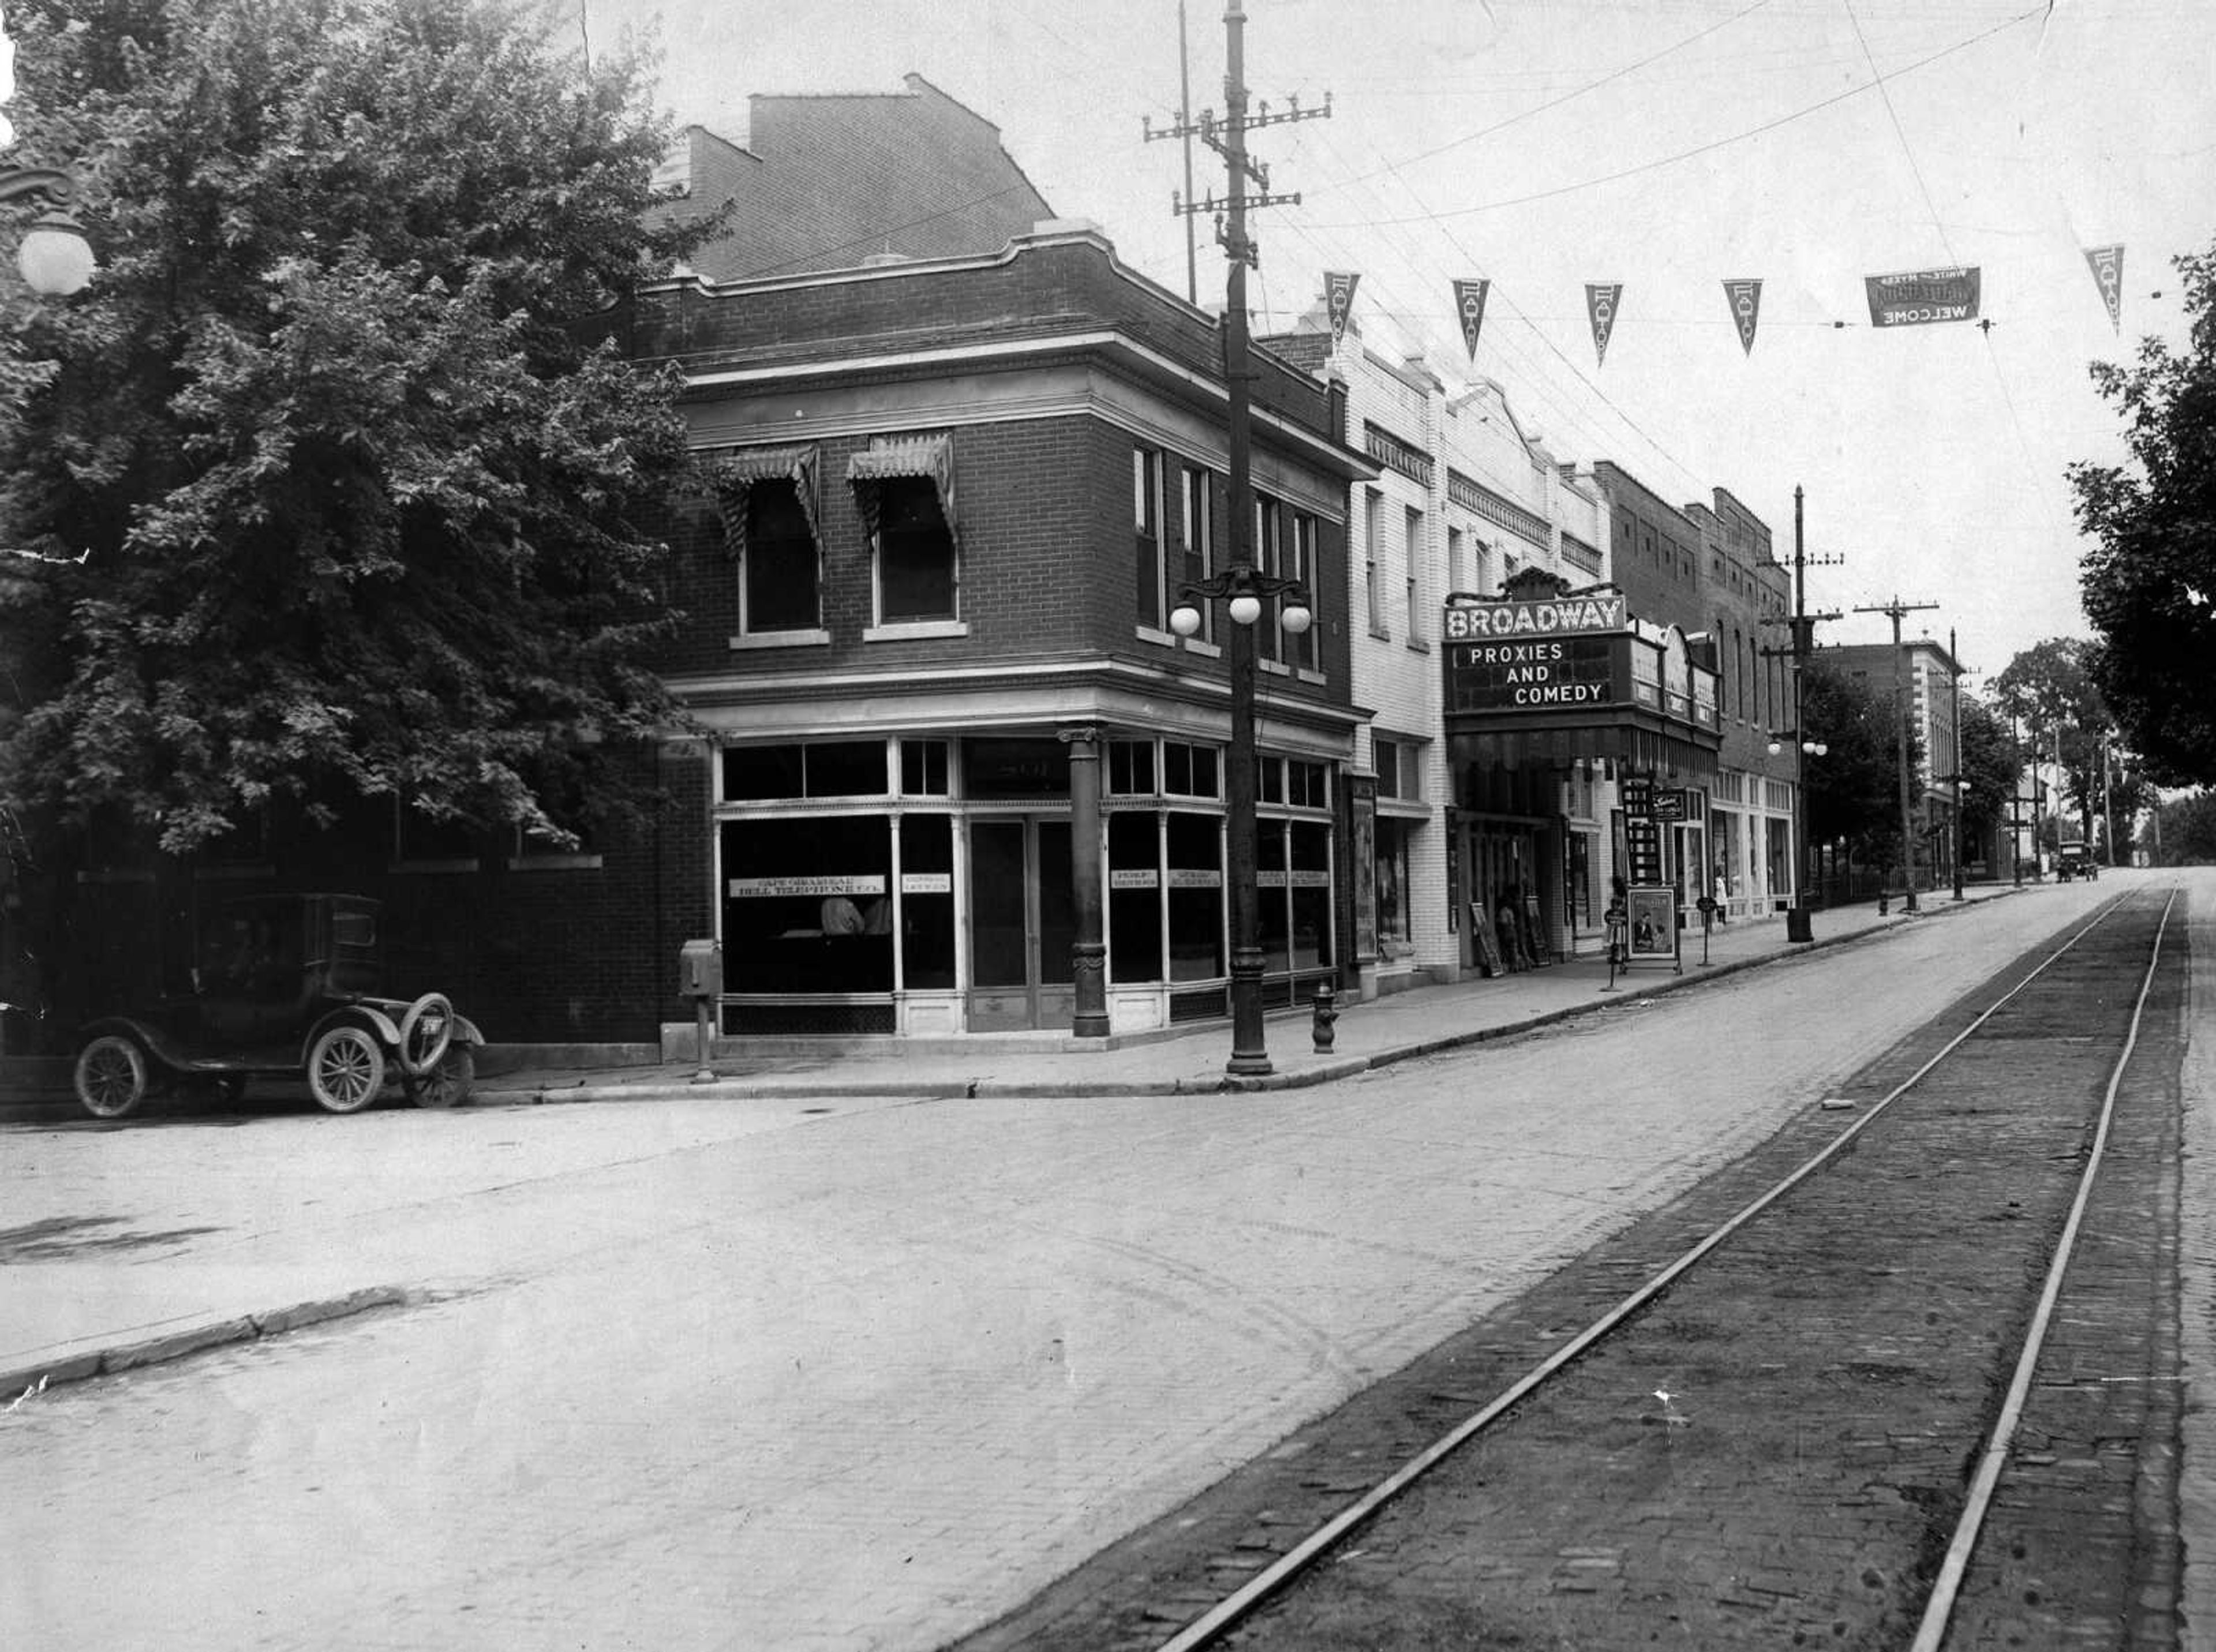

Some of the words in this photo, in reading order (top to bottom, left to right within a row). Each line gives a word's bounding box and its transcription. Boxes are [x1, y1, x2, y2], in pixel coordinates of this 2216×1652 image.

[1446, 600, 1621, 637] BROADWAY
[1472, 643, 1562, 664] PROXIES
[1507, 666, 1548, 683] AND
[1515, 684, 1601, 704] COMEDY
